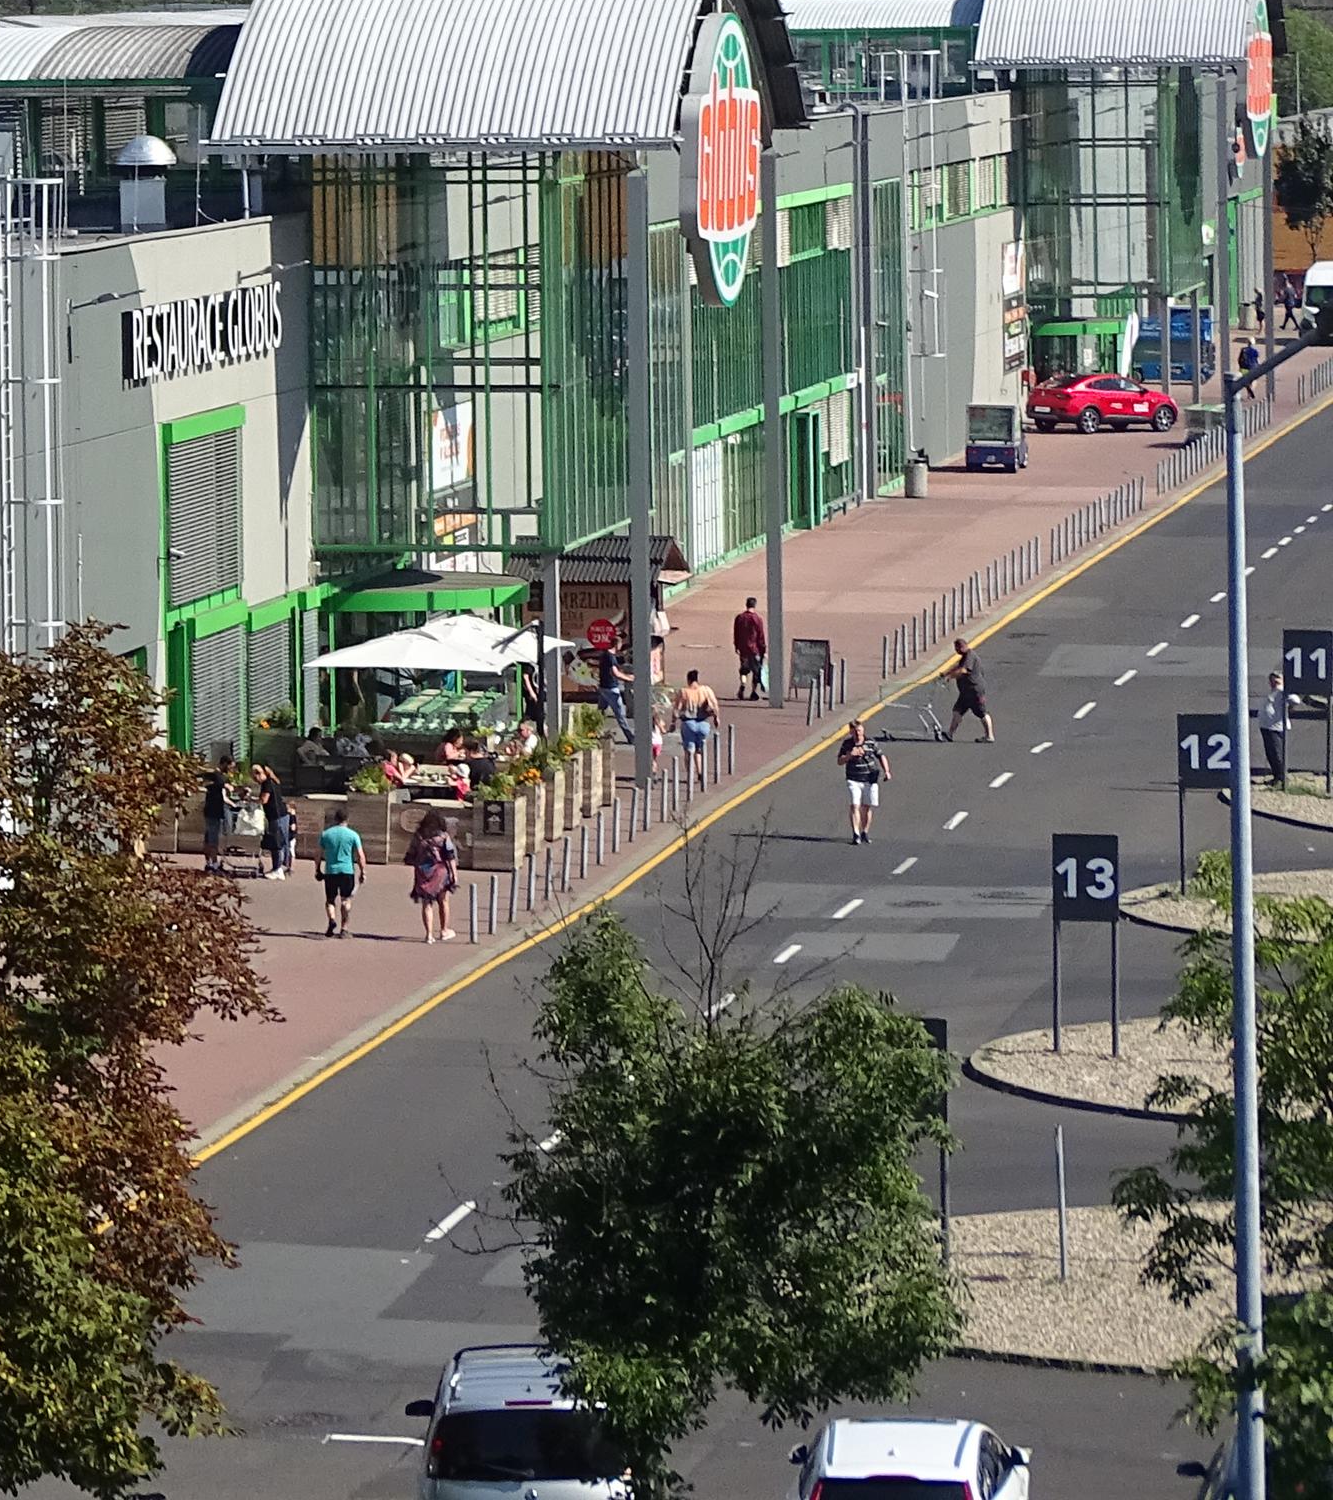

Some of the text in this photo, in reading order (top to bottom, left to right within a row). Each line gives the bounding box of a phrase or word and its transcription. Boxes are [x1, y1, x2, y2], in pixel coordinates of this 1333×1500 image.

[133, 281, 282, 380] RESTAURACE GLOBUS
[1285, 647, 1327, 680] 11
[1180, 733, 1231, 770] 12
[1055, 857, 1116, 900] 13
